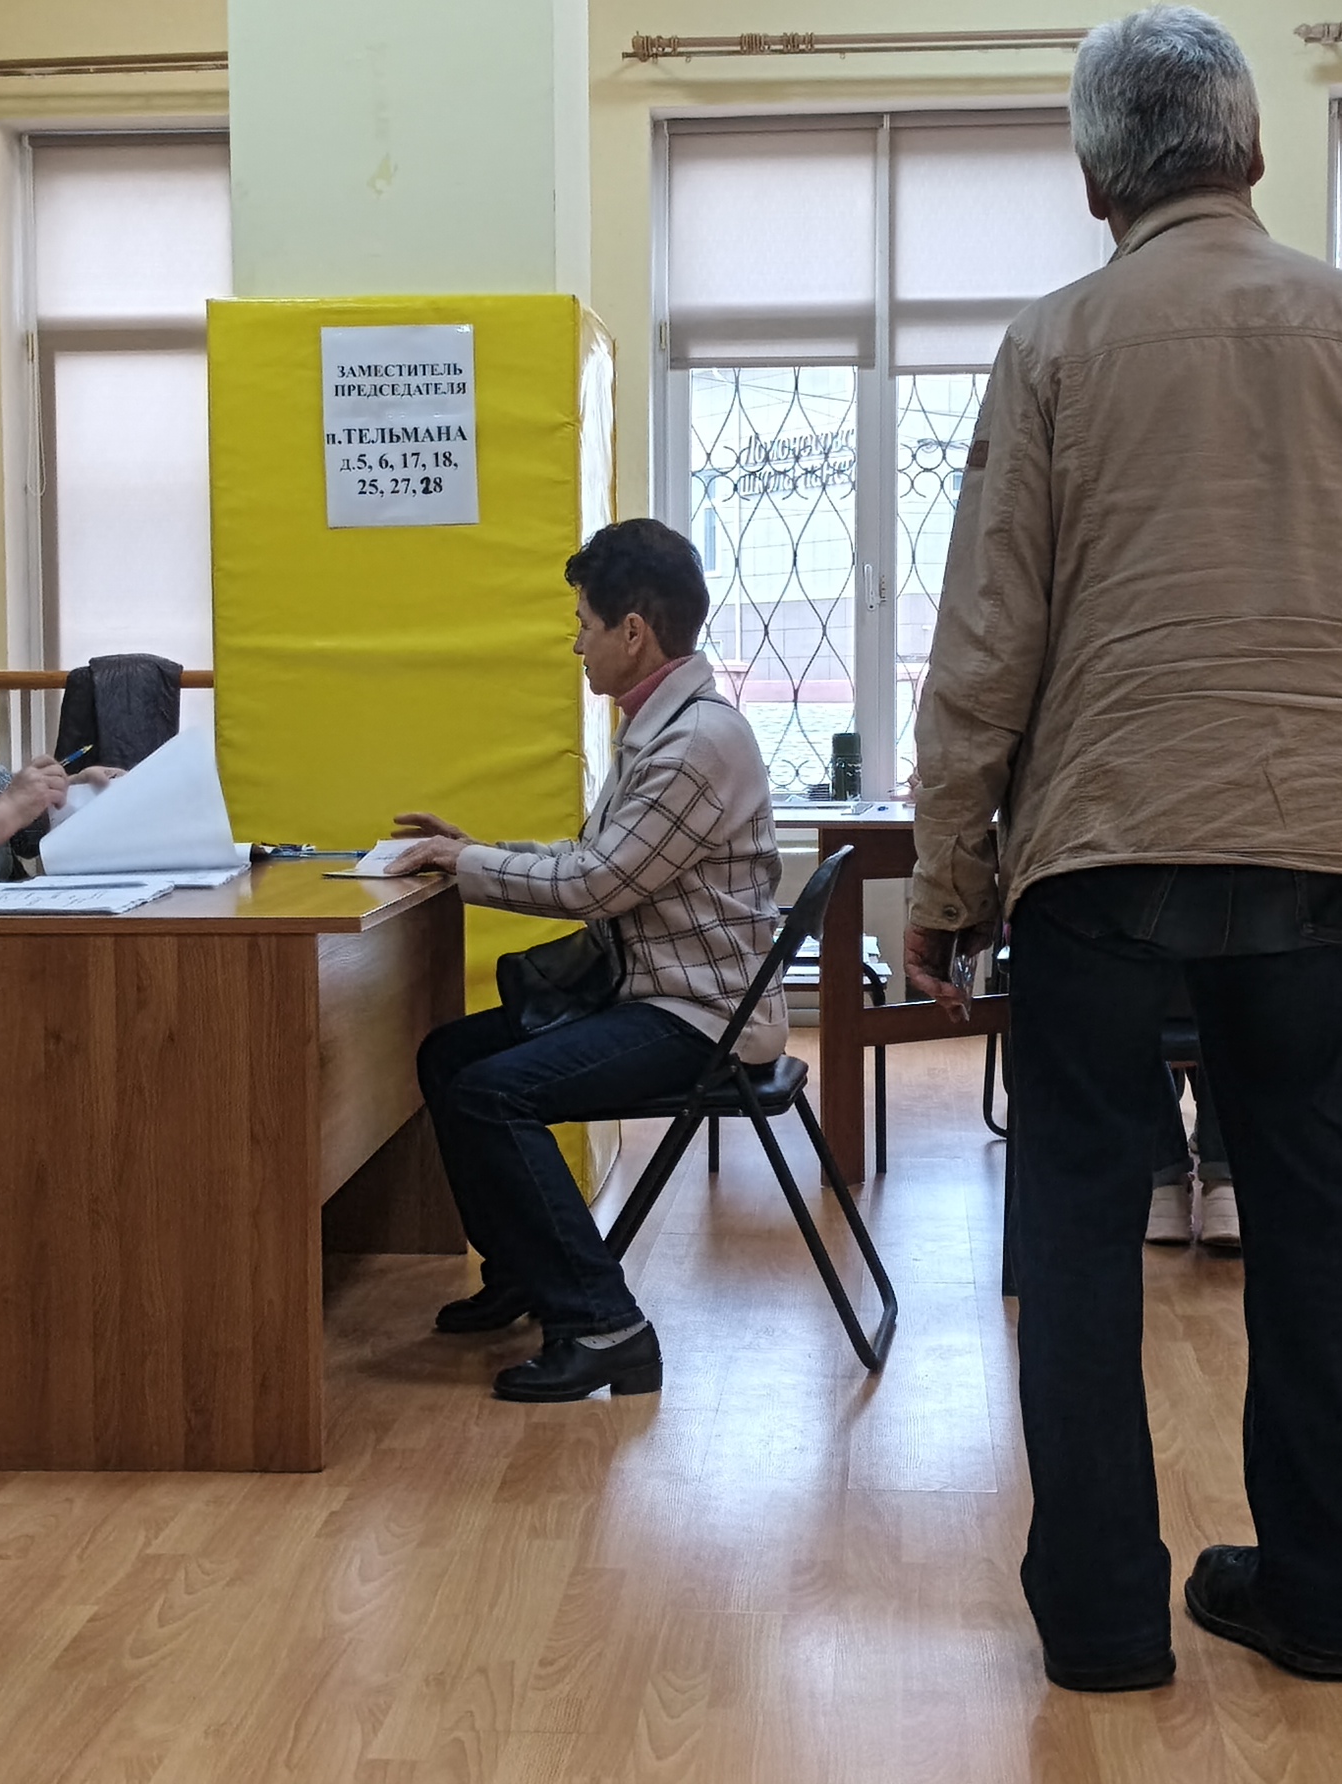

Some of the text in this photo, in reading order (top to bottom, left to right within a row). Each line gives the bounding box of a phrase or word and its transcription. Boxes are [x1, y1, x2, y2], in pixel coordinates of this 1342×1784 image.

[337, 363, 463, 378] ЗАМЕСТИТЕЛЬ
[334, 382, 467, 398] ПРЕДСЕДАТЕЛЯ
[378, 453, 395, 471] 6,
[400, 452, 426, 470] 17,
[433, 451, 459, 470] 18,
[357, 479, 385, 497] 25,
[390, 478, 417, 497] 27,
